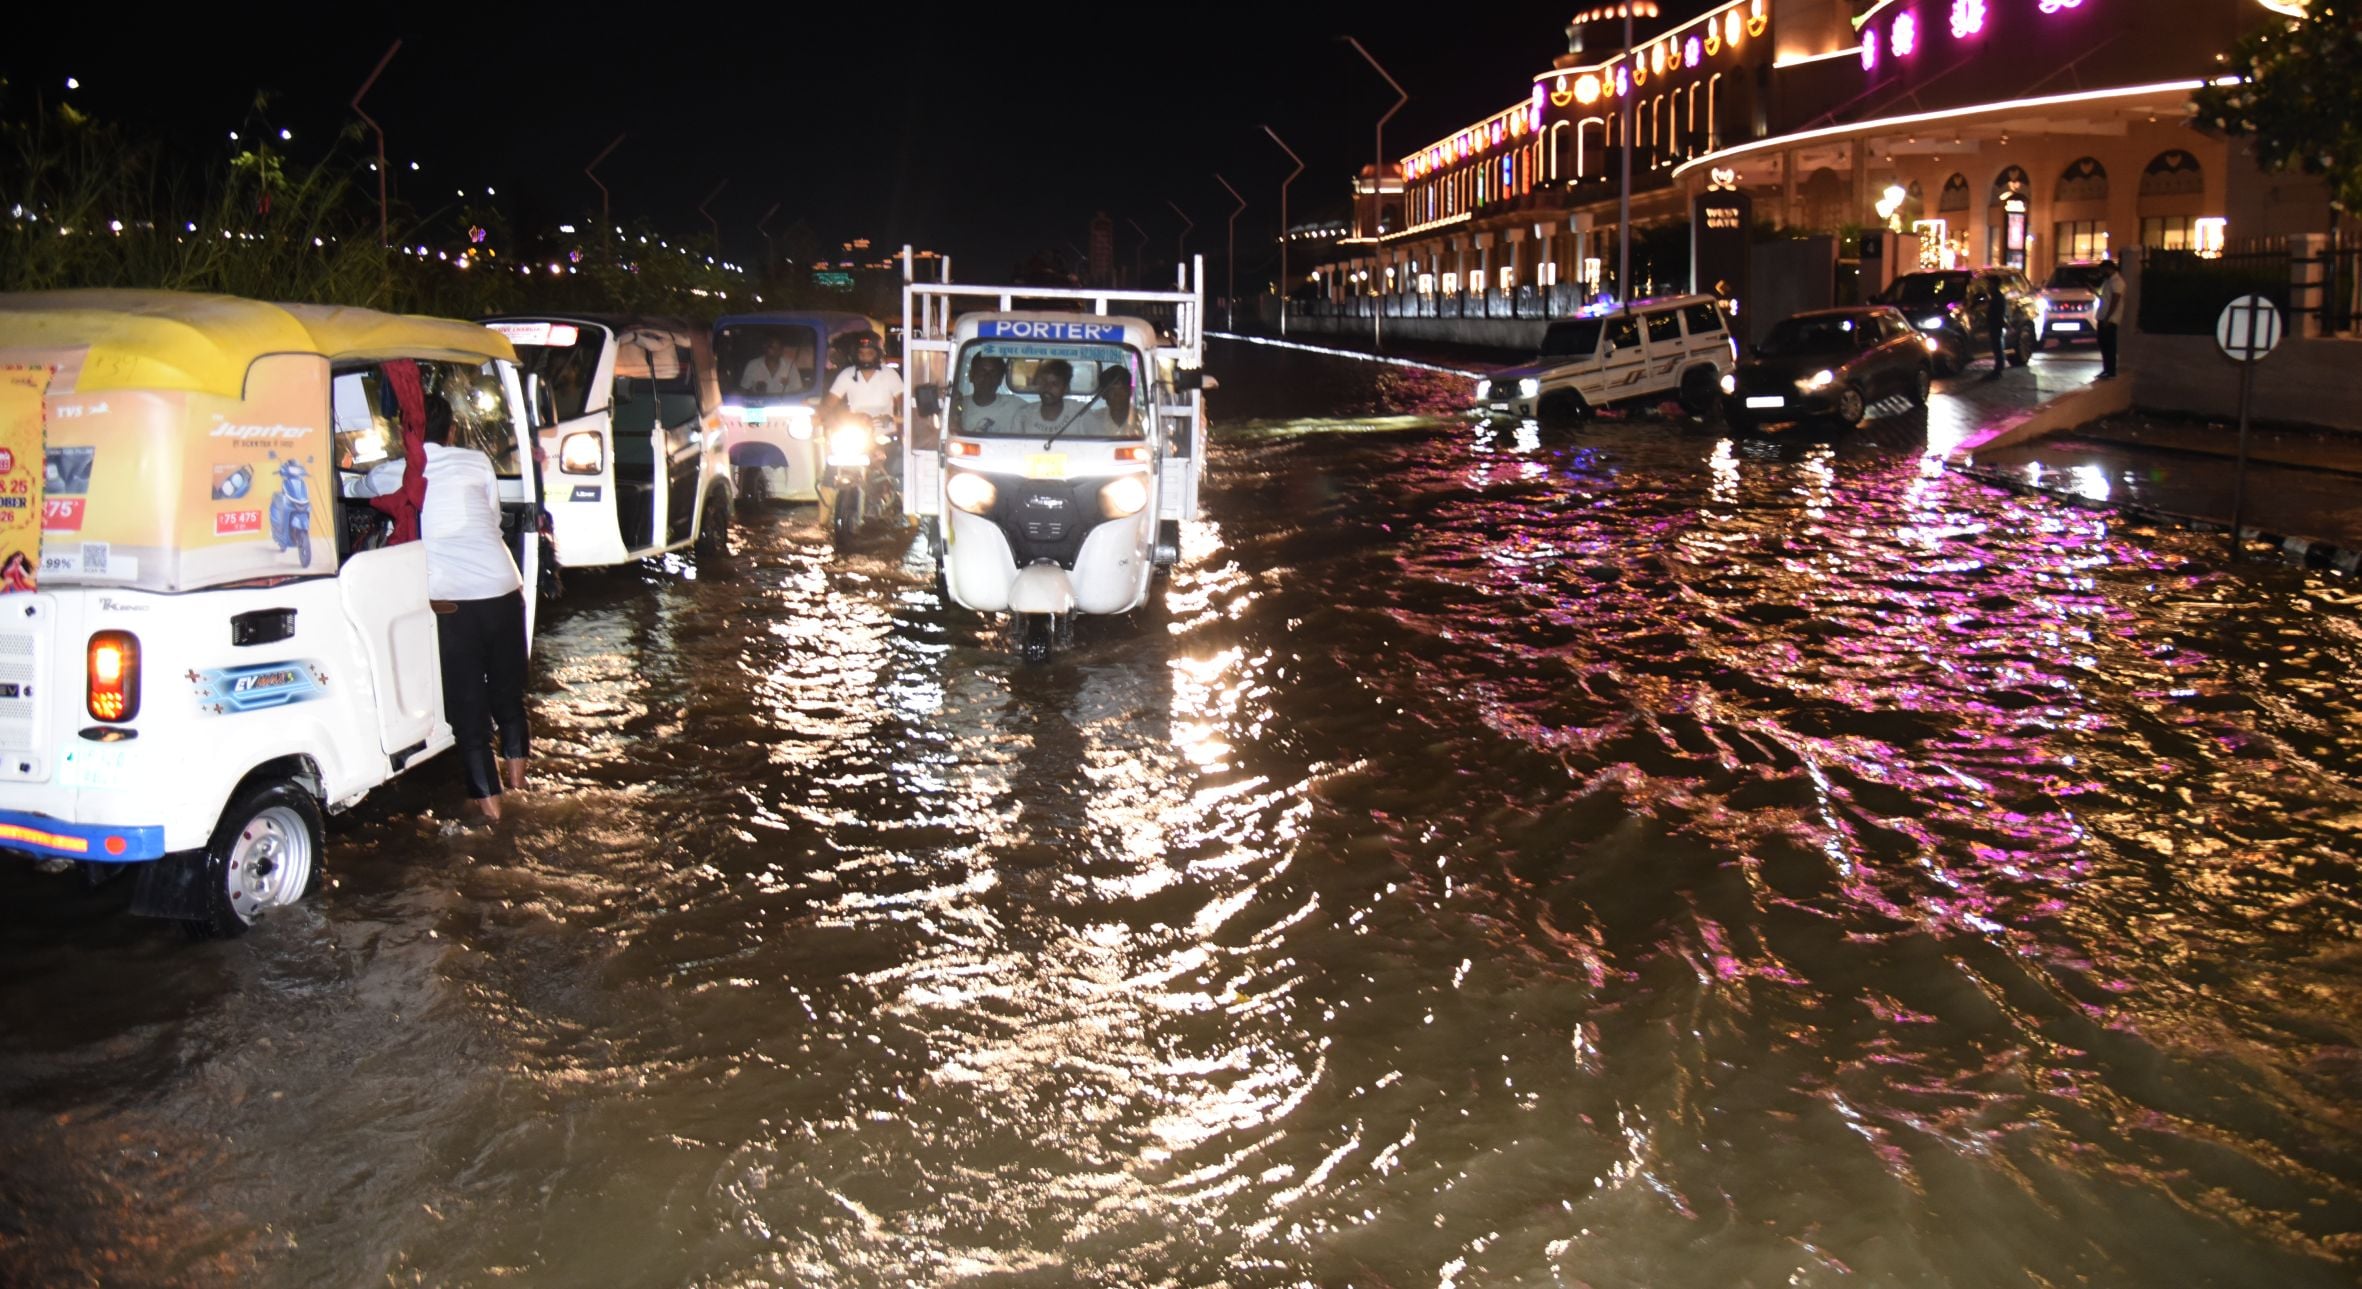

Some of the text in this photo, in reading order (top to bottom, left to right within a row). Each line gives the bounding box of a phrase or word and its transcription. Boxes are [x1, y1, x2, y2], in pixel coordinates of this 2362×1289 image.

[1705, 208, 1739, 218] WEST
[1706, 218, 1739, 228] GATE
[996, 321, 1101, 339] PORTER
[57, 406, 83, 418] TVS
[210, 422, 314, 438] Jupiter
